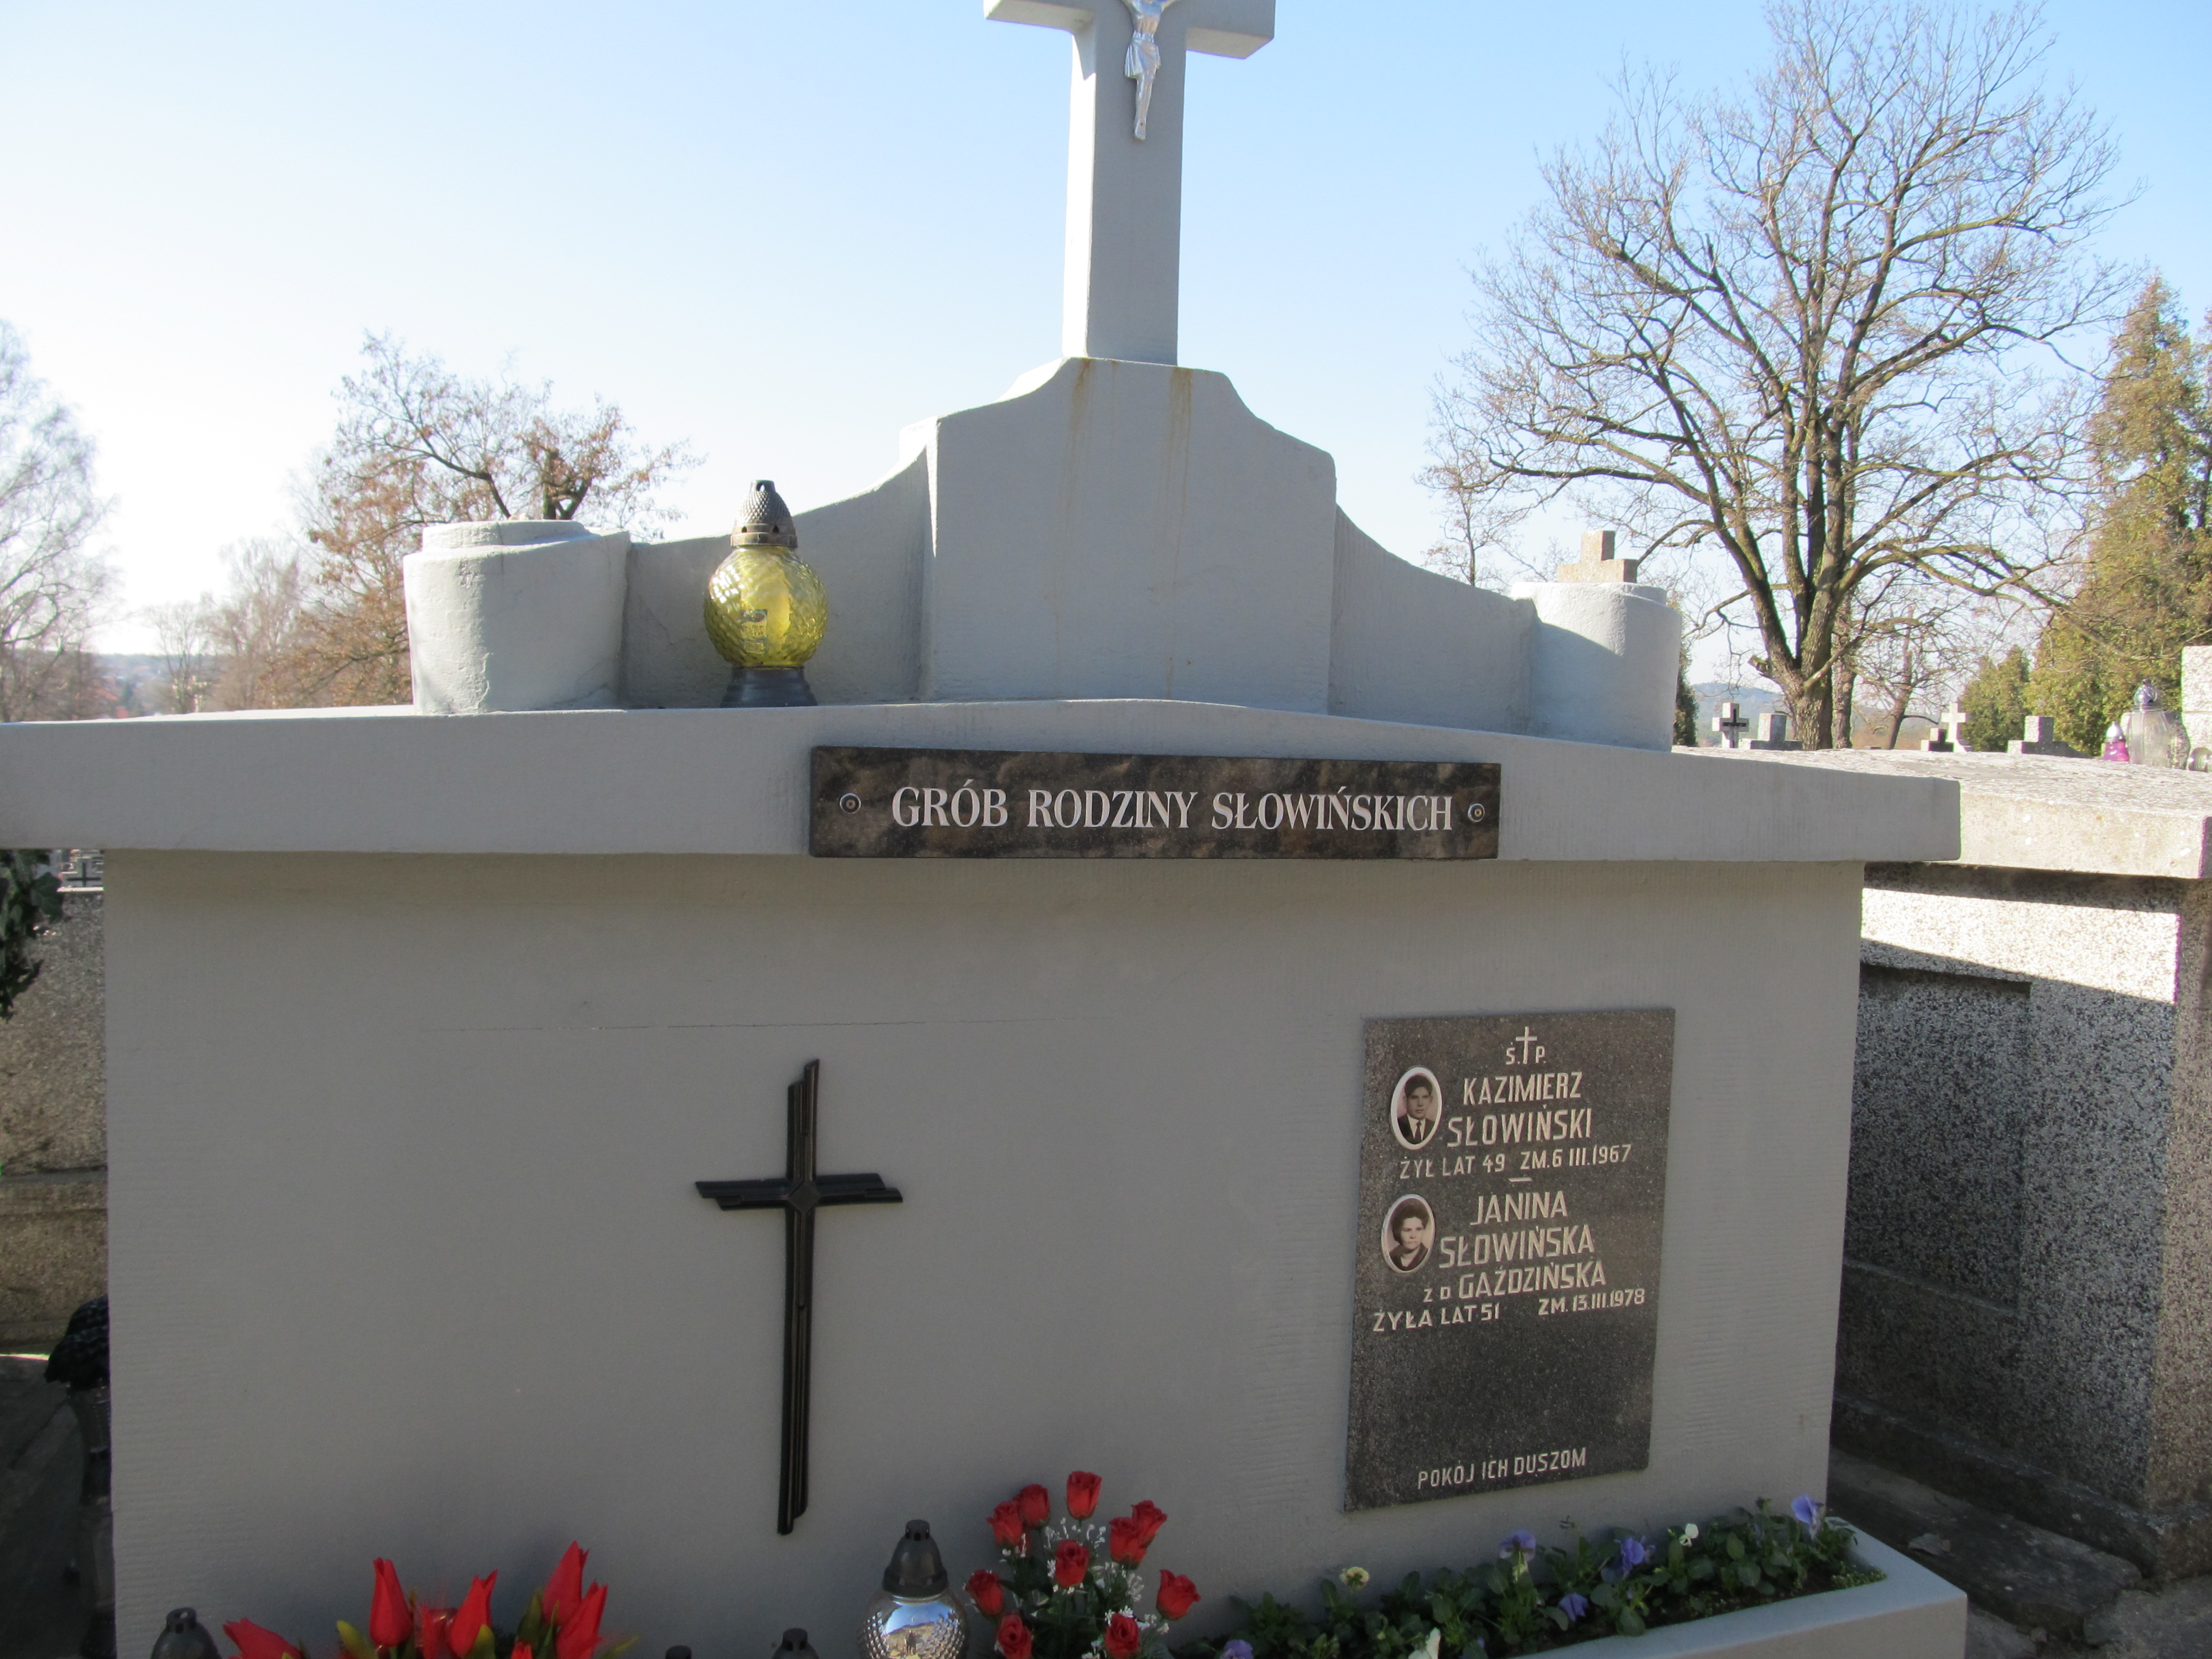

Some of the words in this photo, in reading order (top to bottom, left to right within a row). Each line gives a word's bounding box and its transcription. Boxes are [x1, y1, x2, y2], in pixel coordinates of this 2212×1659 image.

[891, 779, 1008, 827] GRÓB
[1028, 789, 1198, 828] RODZINY
[1211, 786, 1454, 831] SŁOWIŃSKICH
[1463, 1071, 1583, 1105] KAZIMIERZ
[1446, 1104, 1593, 1147] SŁOWIŃSKI
[1400, 1156, 1434, 1180] ŻYŁ
[1442, 1155, 1475, 1176] LAT
[1482, 1153, 1505, 1173] 49
[1470, 1190, 1568, 1226] JANINA
[1439, 1224, 1595, 1269] SŁOWIŃSKA
[1441, 1305, 1477, 1326] LAT
[1480, 1302, 1500, 1322] 51
[1538, 1296, 1569, 1316] ZM.
[1418, 1460, 1474, 1490] POKÓJ
[1482, 1458, 1509, 1480] ICH
[1514, 1447, 1587, 1476] DUSZOM
